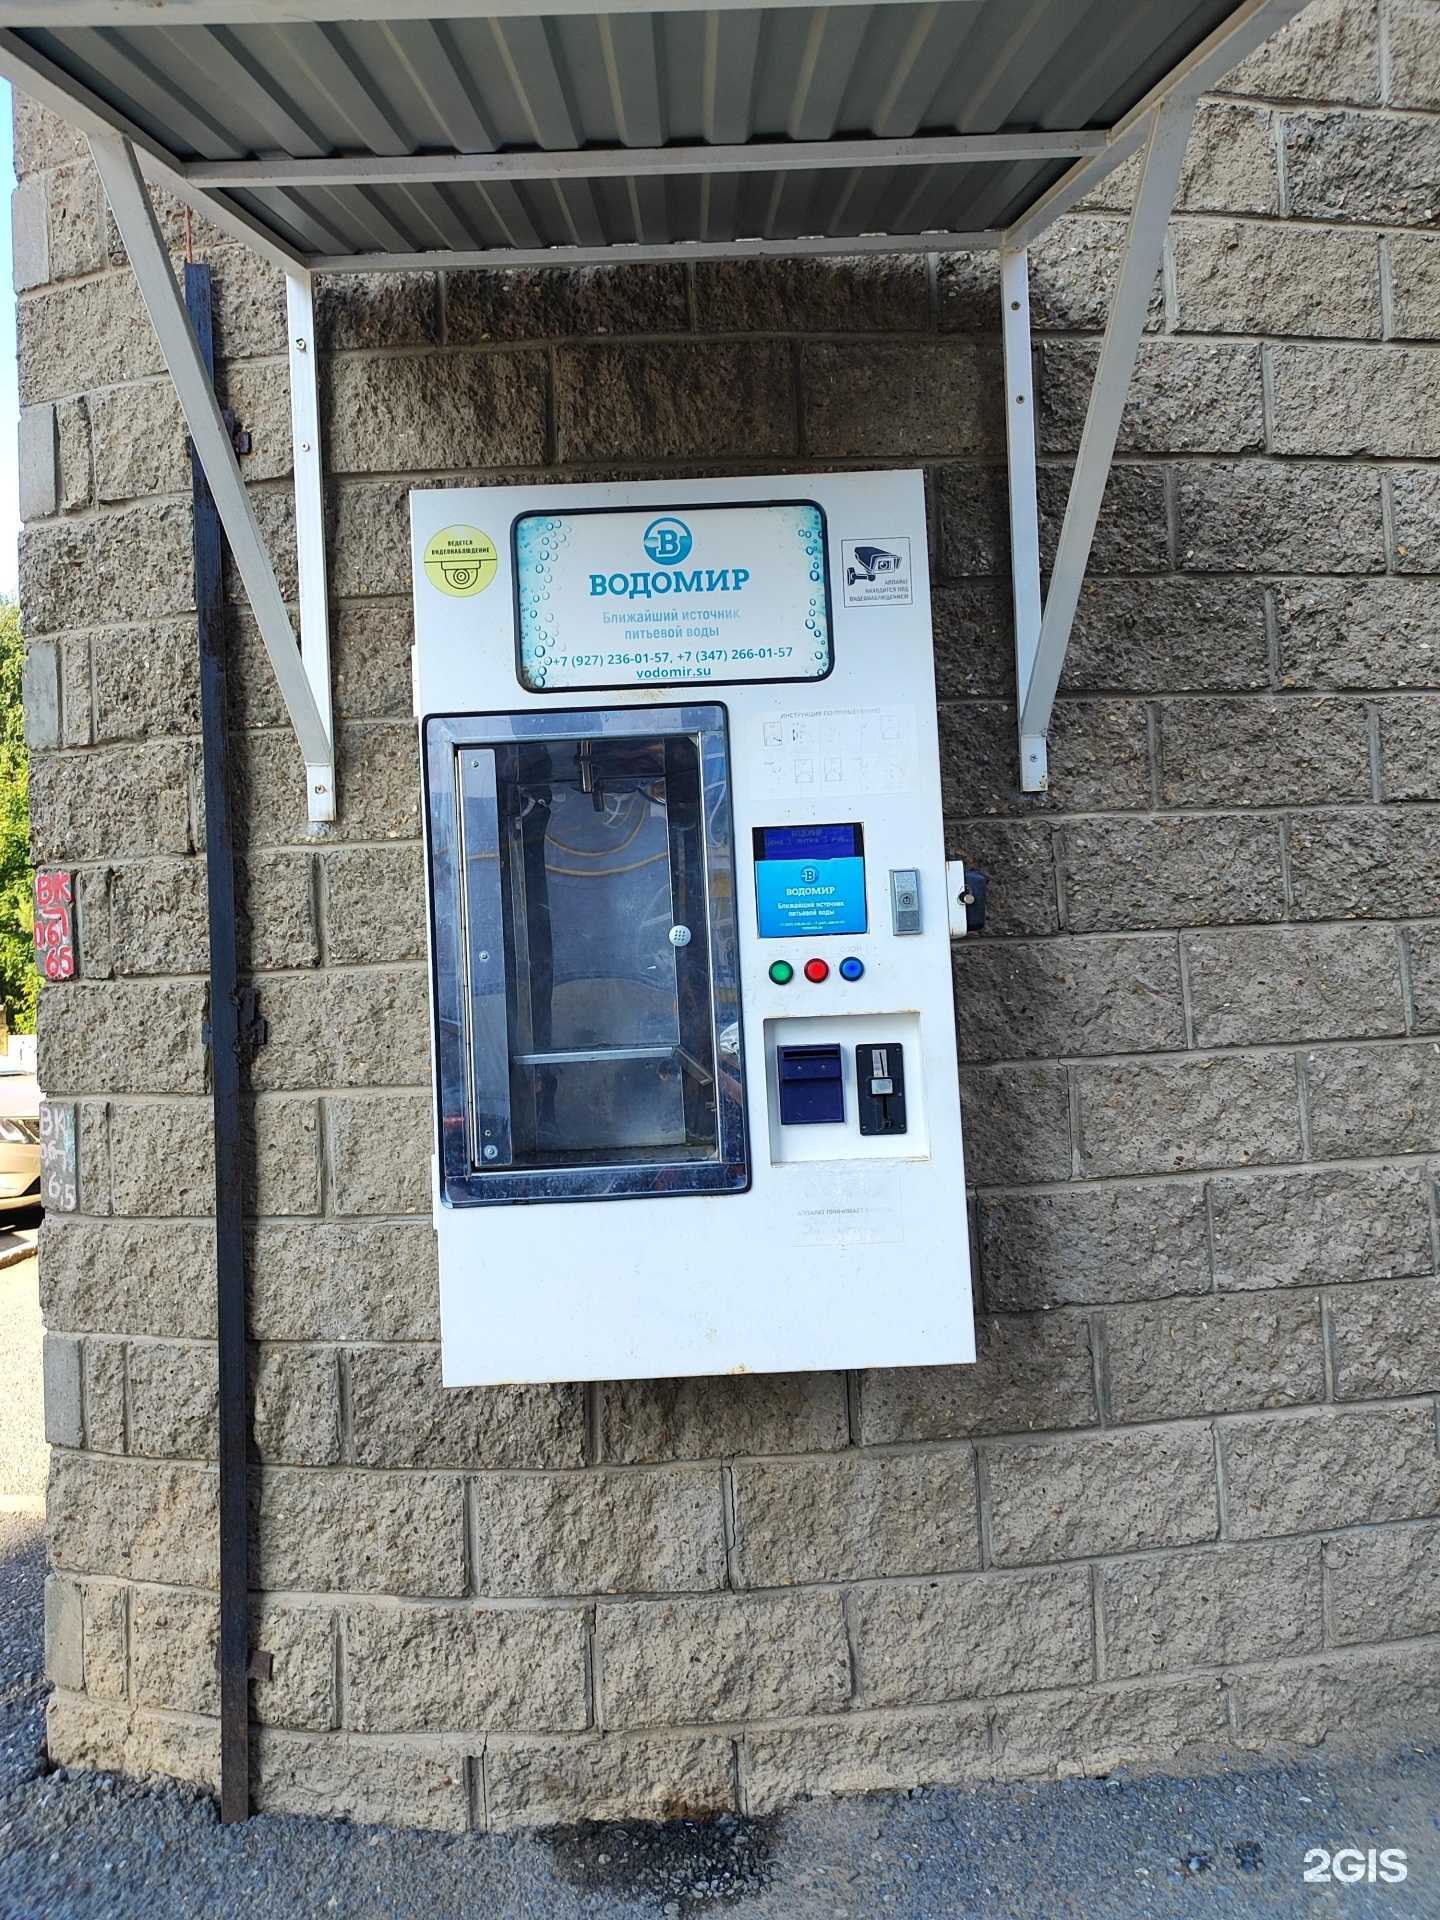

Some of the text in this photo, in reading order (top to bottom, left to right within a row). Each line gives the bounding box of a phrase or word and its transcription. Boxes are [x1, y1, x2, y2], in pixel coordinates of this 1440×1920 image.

[588, 568, 750, 600] ВОДОМИР
[602, 608, 742, 624] Ближайший источник
[624, 625, 719, 640] питьевой воды
[571, 654, 604, 668] (927)
[607, 652, 673, 665] 236-01-57,
[677, 651, 692, 662] +7
[695, 649, 728, 663] (347)
[731, 646, 793, 660] 266-01-57
[636, 666, 711, 679] vodomir.su
[785, 886, 836, 897] ВОДОМИР
